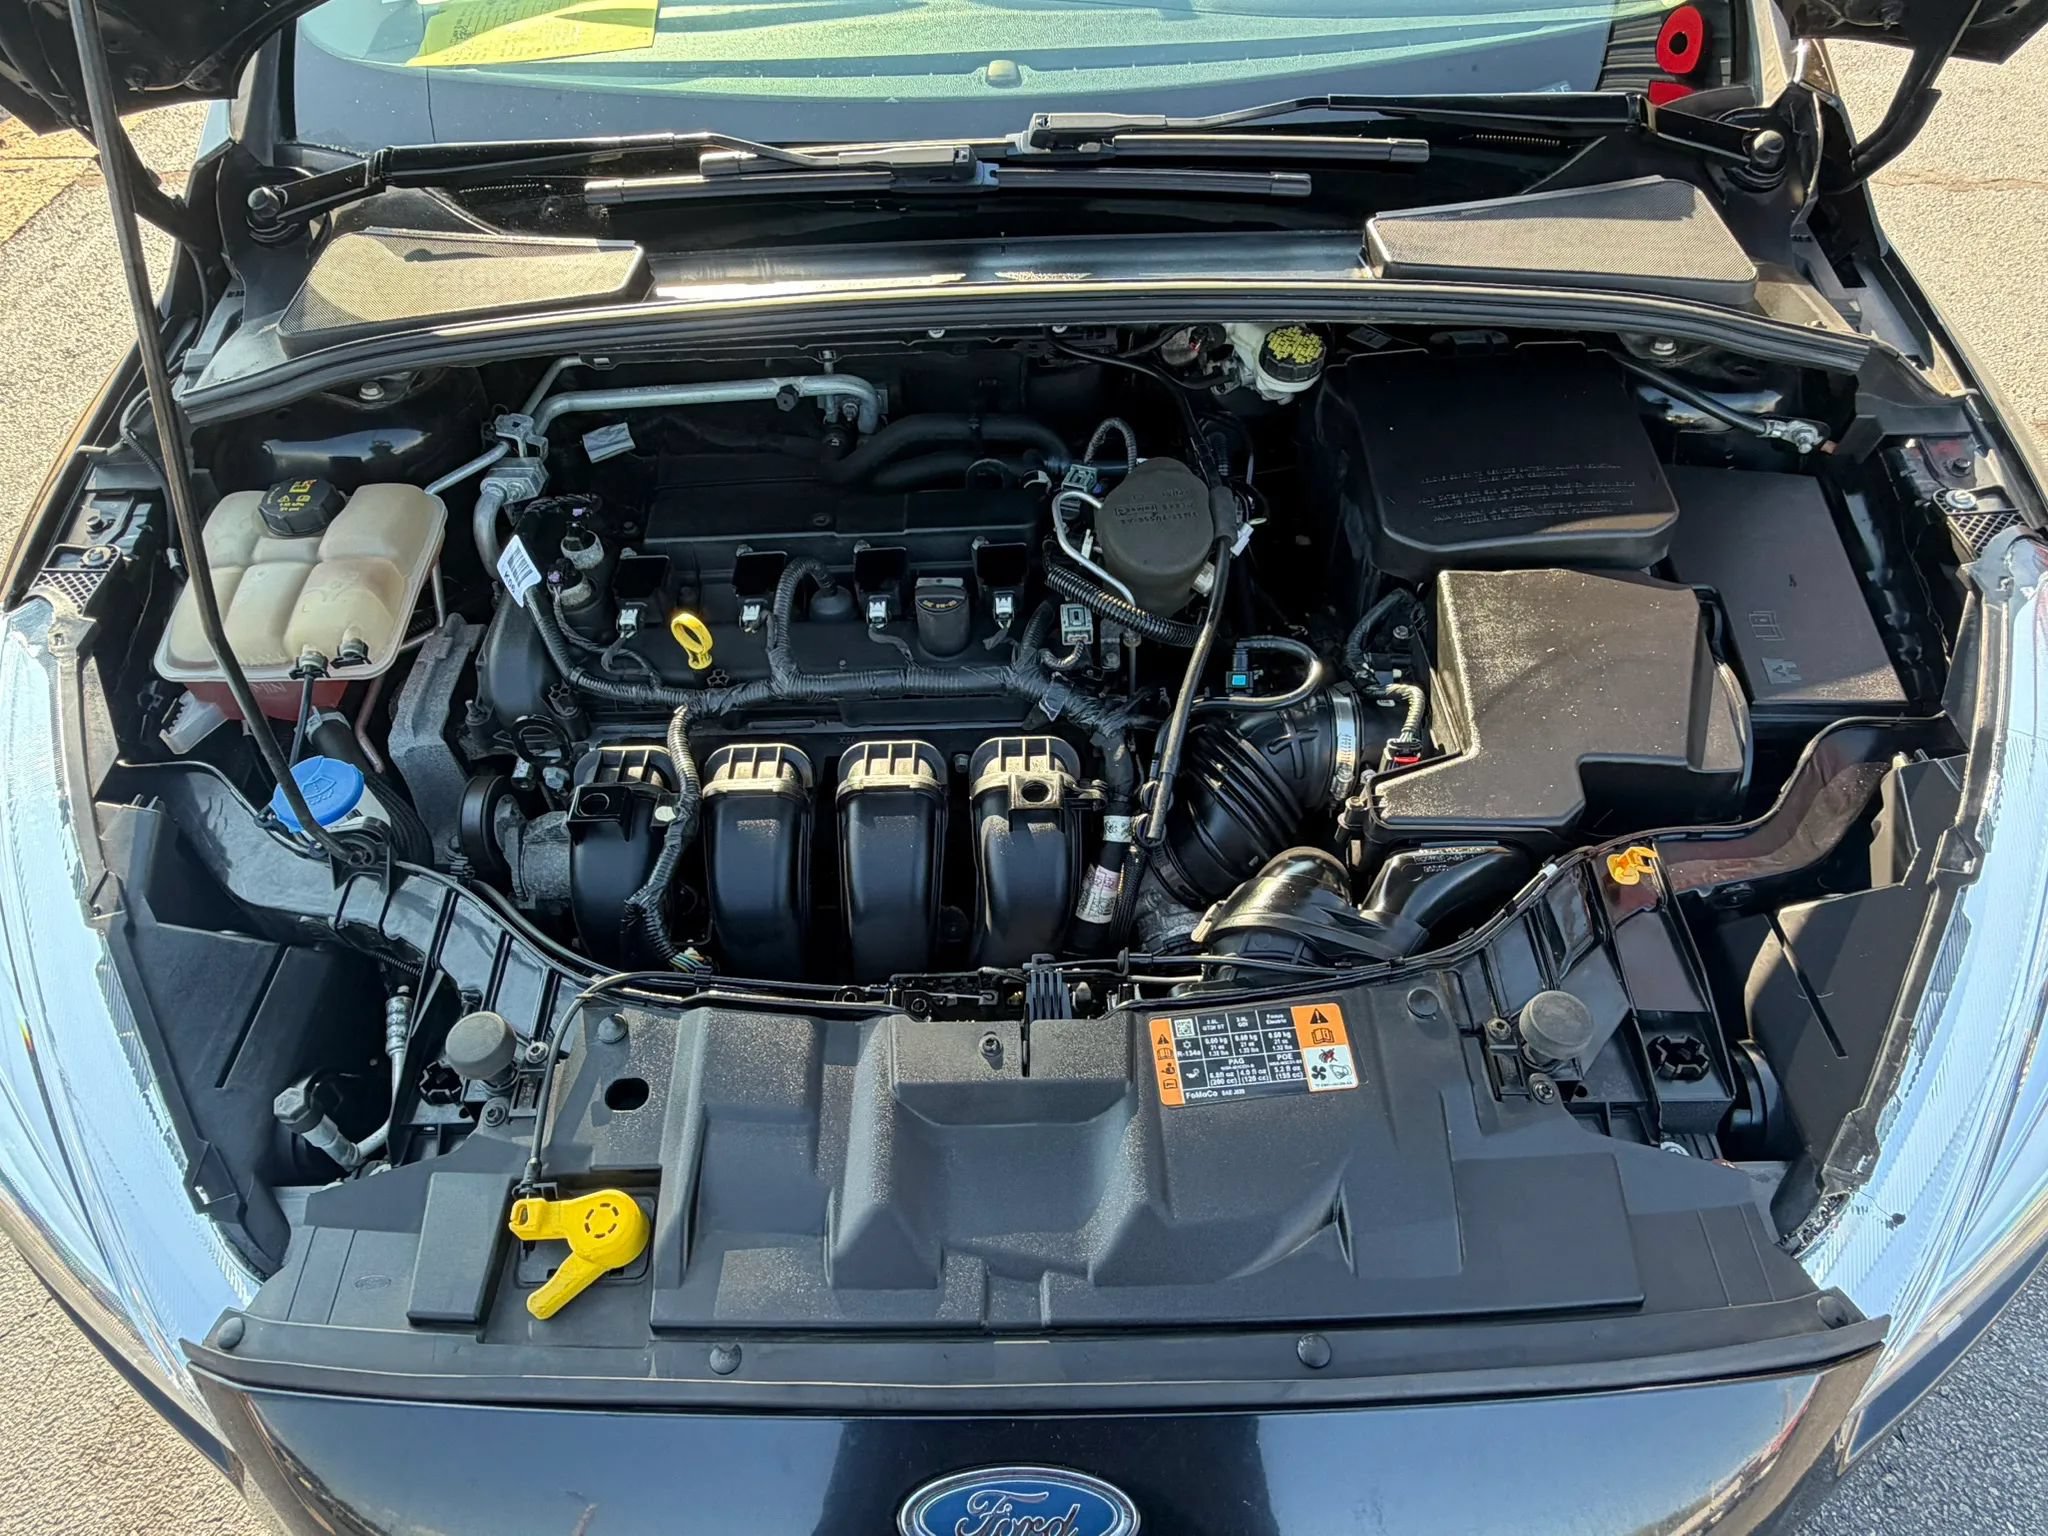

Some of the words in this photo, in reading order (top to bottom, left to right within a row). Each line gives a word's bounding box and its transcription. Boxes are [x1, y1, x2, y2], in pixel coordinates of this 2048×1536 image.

[1249, 1033, 1258, 1041] kg
[1282, 1030, 1291, 1038] kg
[1218, 1036, 1228, 1044] kg
[1177, 1049, 1201, 1057] R-134a
[1225, 1077, 1237, 1085] cc)
[1185, 1089, 1218, 1099] FoMoCo
[954, 1490, 1080, 1536] Ford
